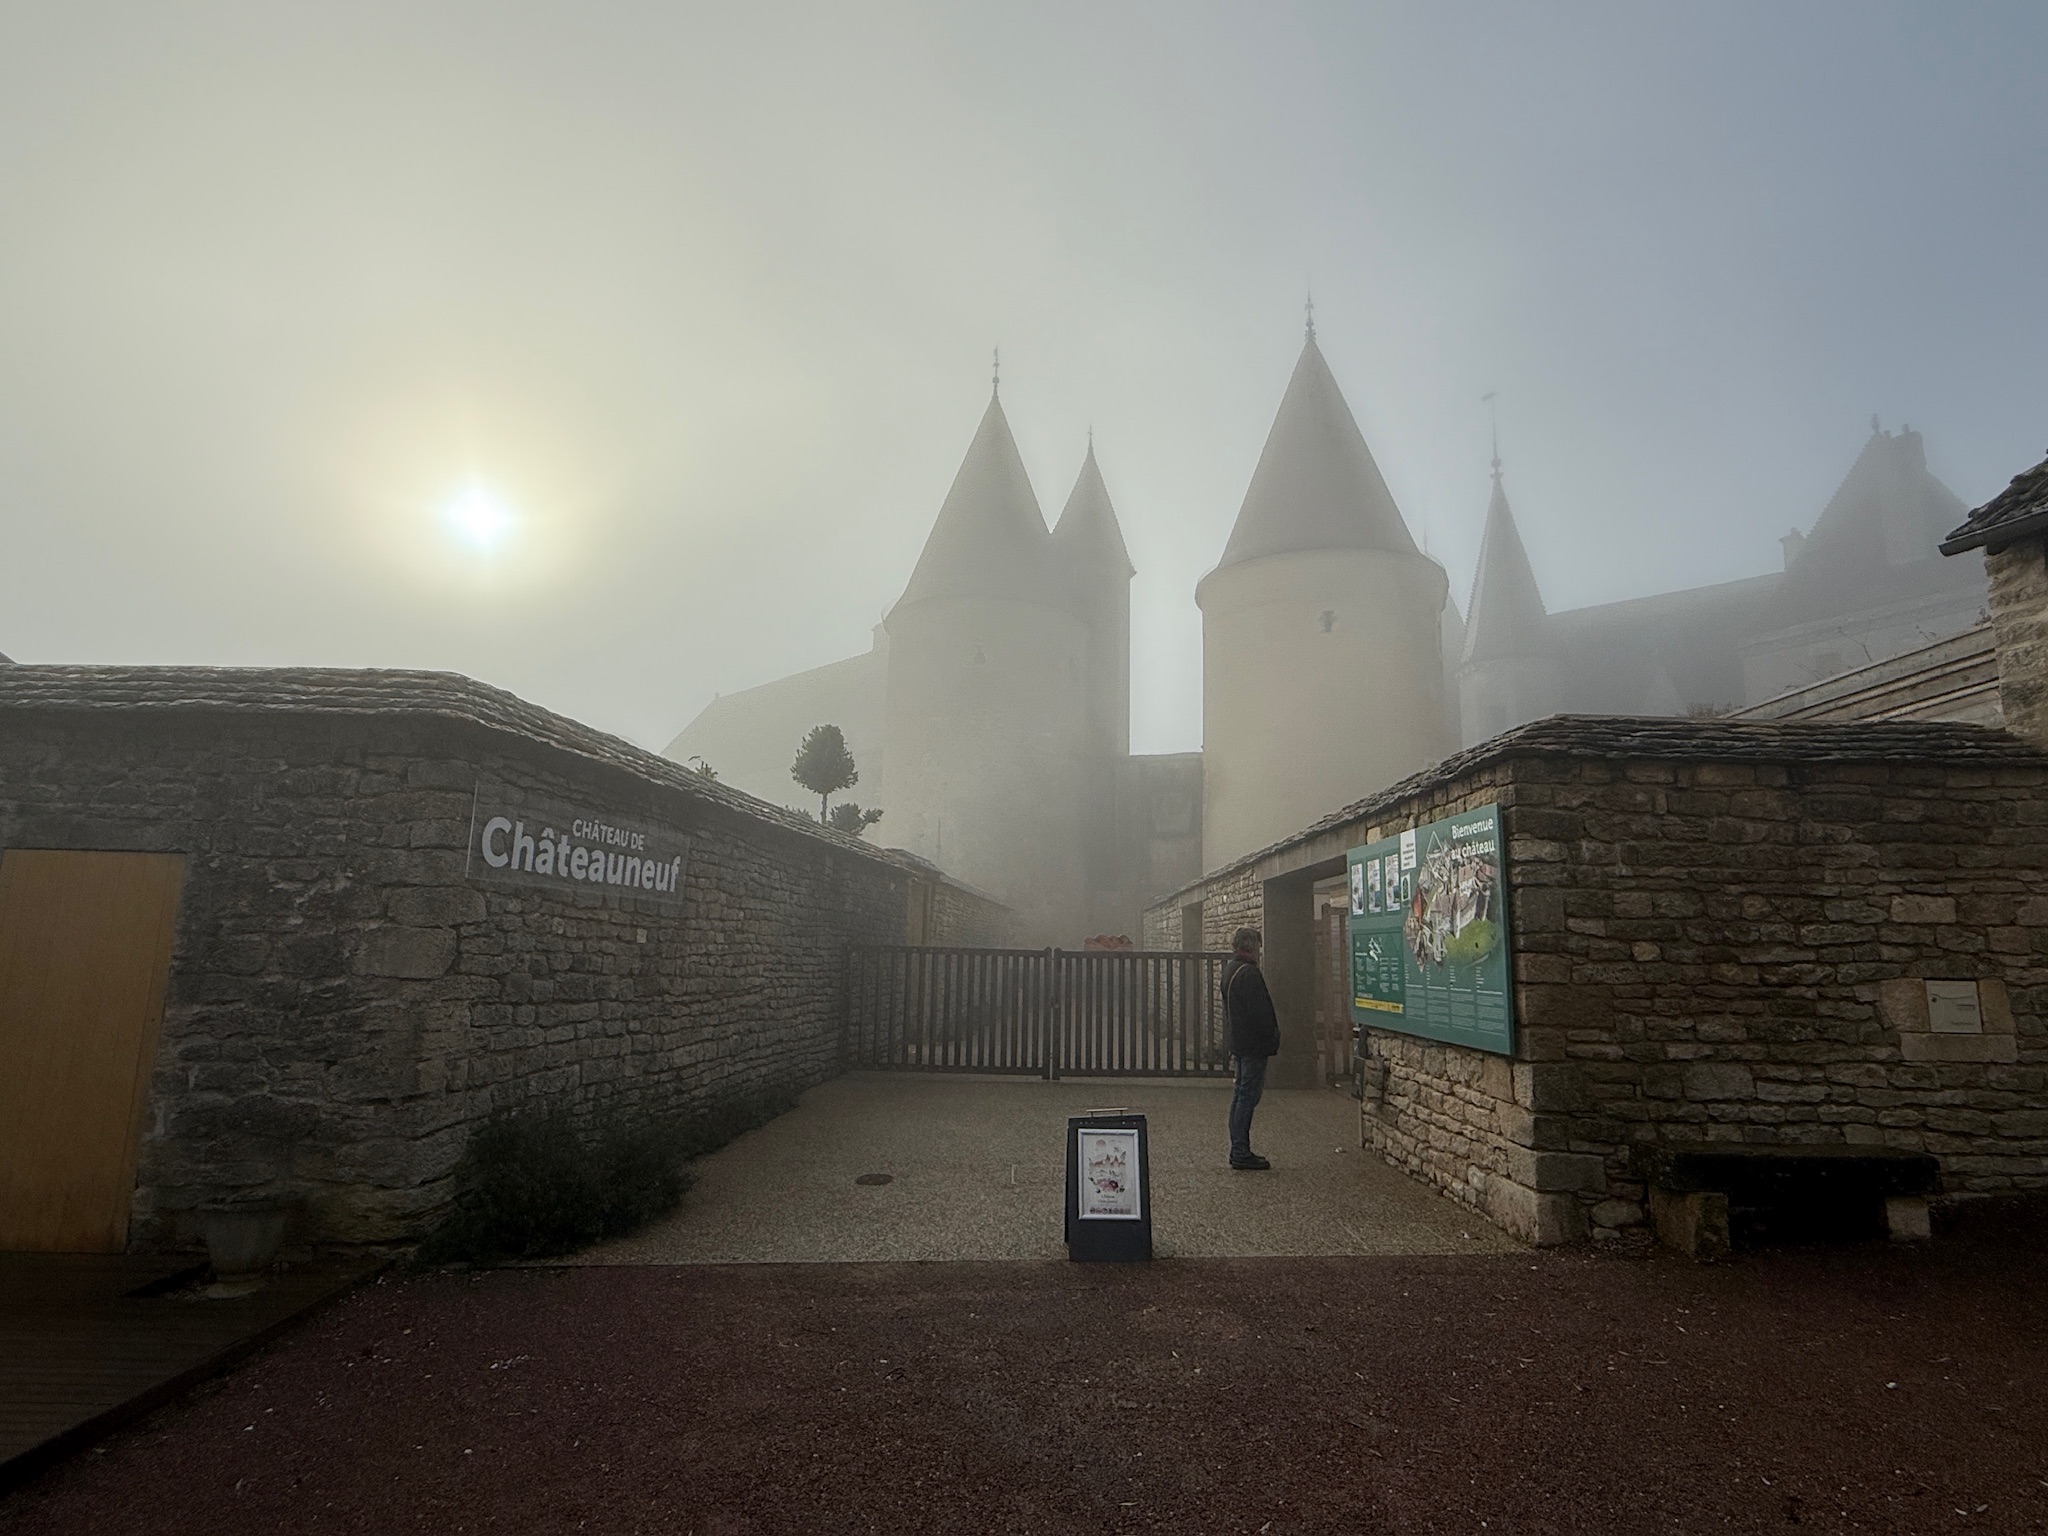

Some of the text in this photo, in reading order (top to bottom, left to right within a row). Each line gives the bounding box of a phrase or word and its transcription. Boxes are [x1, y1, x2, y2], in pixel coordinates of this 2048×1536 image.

[572, 819, 645, 851] CHÂTEAU DE
[1451, 817, 1494, 840] Bienvenue
[481, 816, 681, 893] Châteauneuf
[1450, 848, 1461, 860] au
[1461, 840, 1496, 857] château
